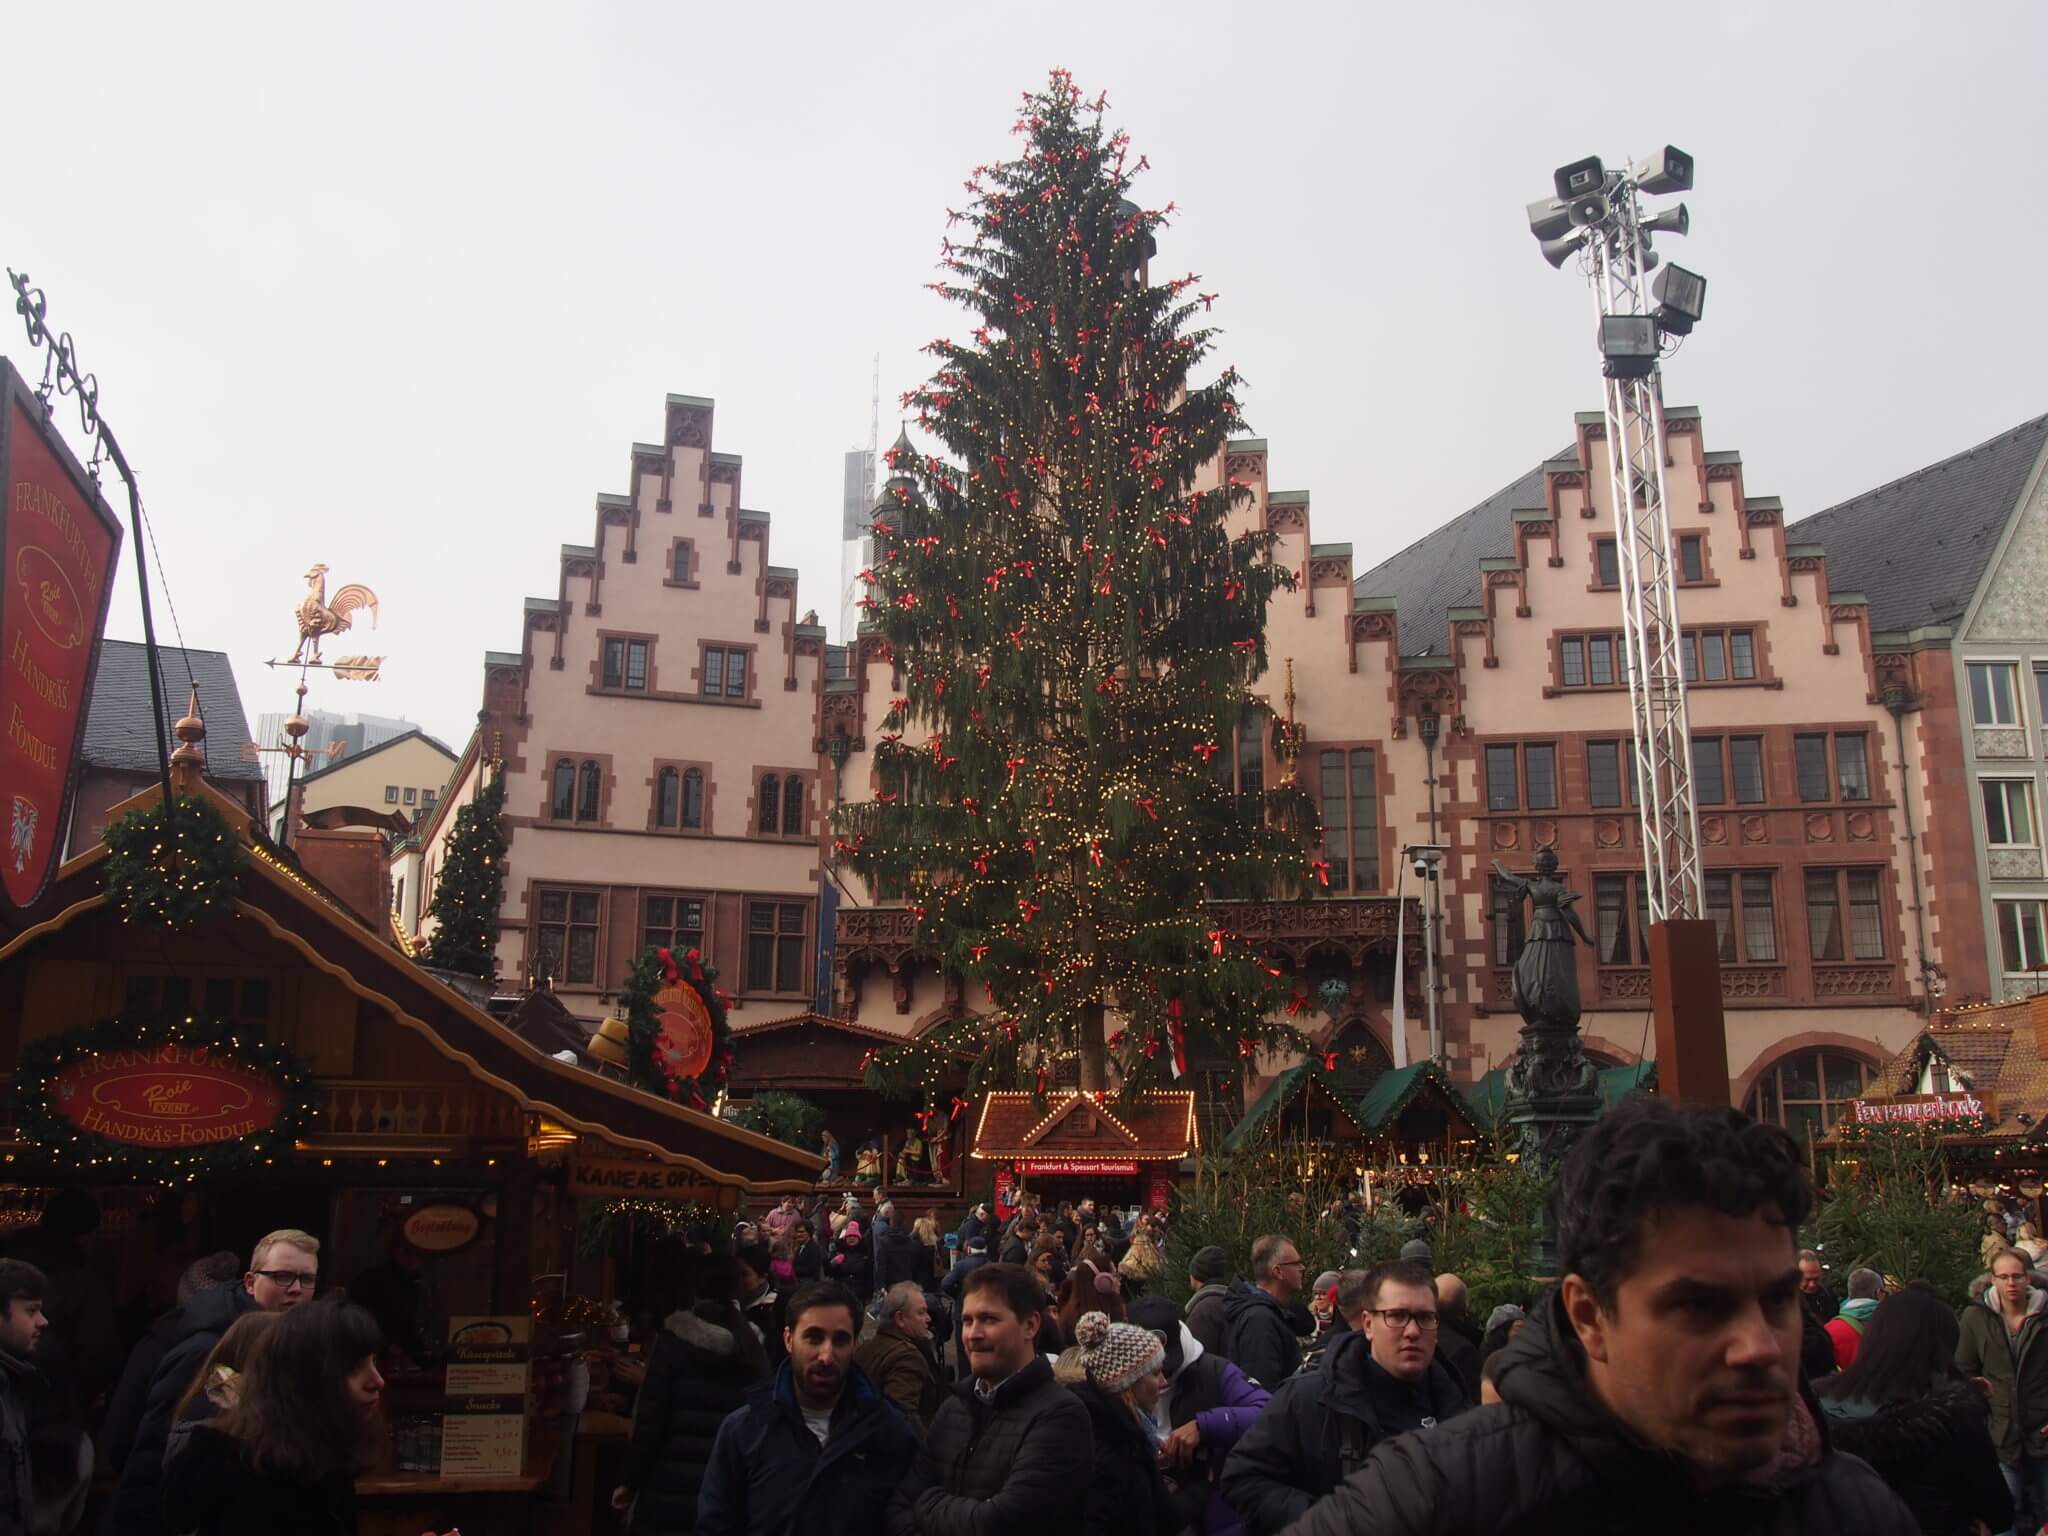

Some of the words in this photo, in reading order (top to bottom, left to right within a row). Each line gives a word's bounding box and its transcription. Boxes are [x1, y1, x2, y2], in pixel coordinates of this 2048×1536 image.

[15, 481, 97, 593] FRANKFURTER
[81, 1107, 257, 1144] HANDKÄS-FONDUE
[1030, 1162, 1062, 1171] Frankfurt
[1063, 1162, 1070, 1171] &
[1070, 1162, 1100, 1173] Spessart
[1101, 1162, 1135, 1172] Tourismus
